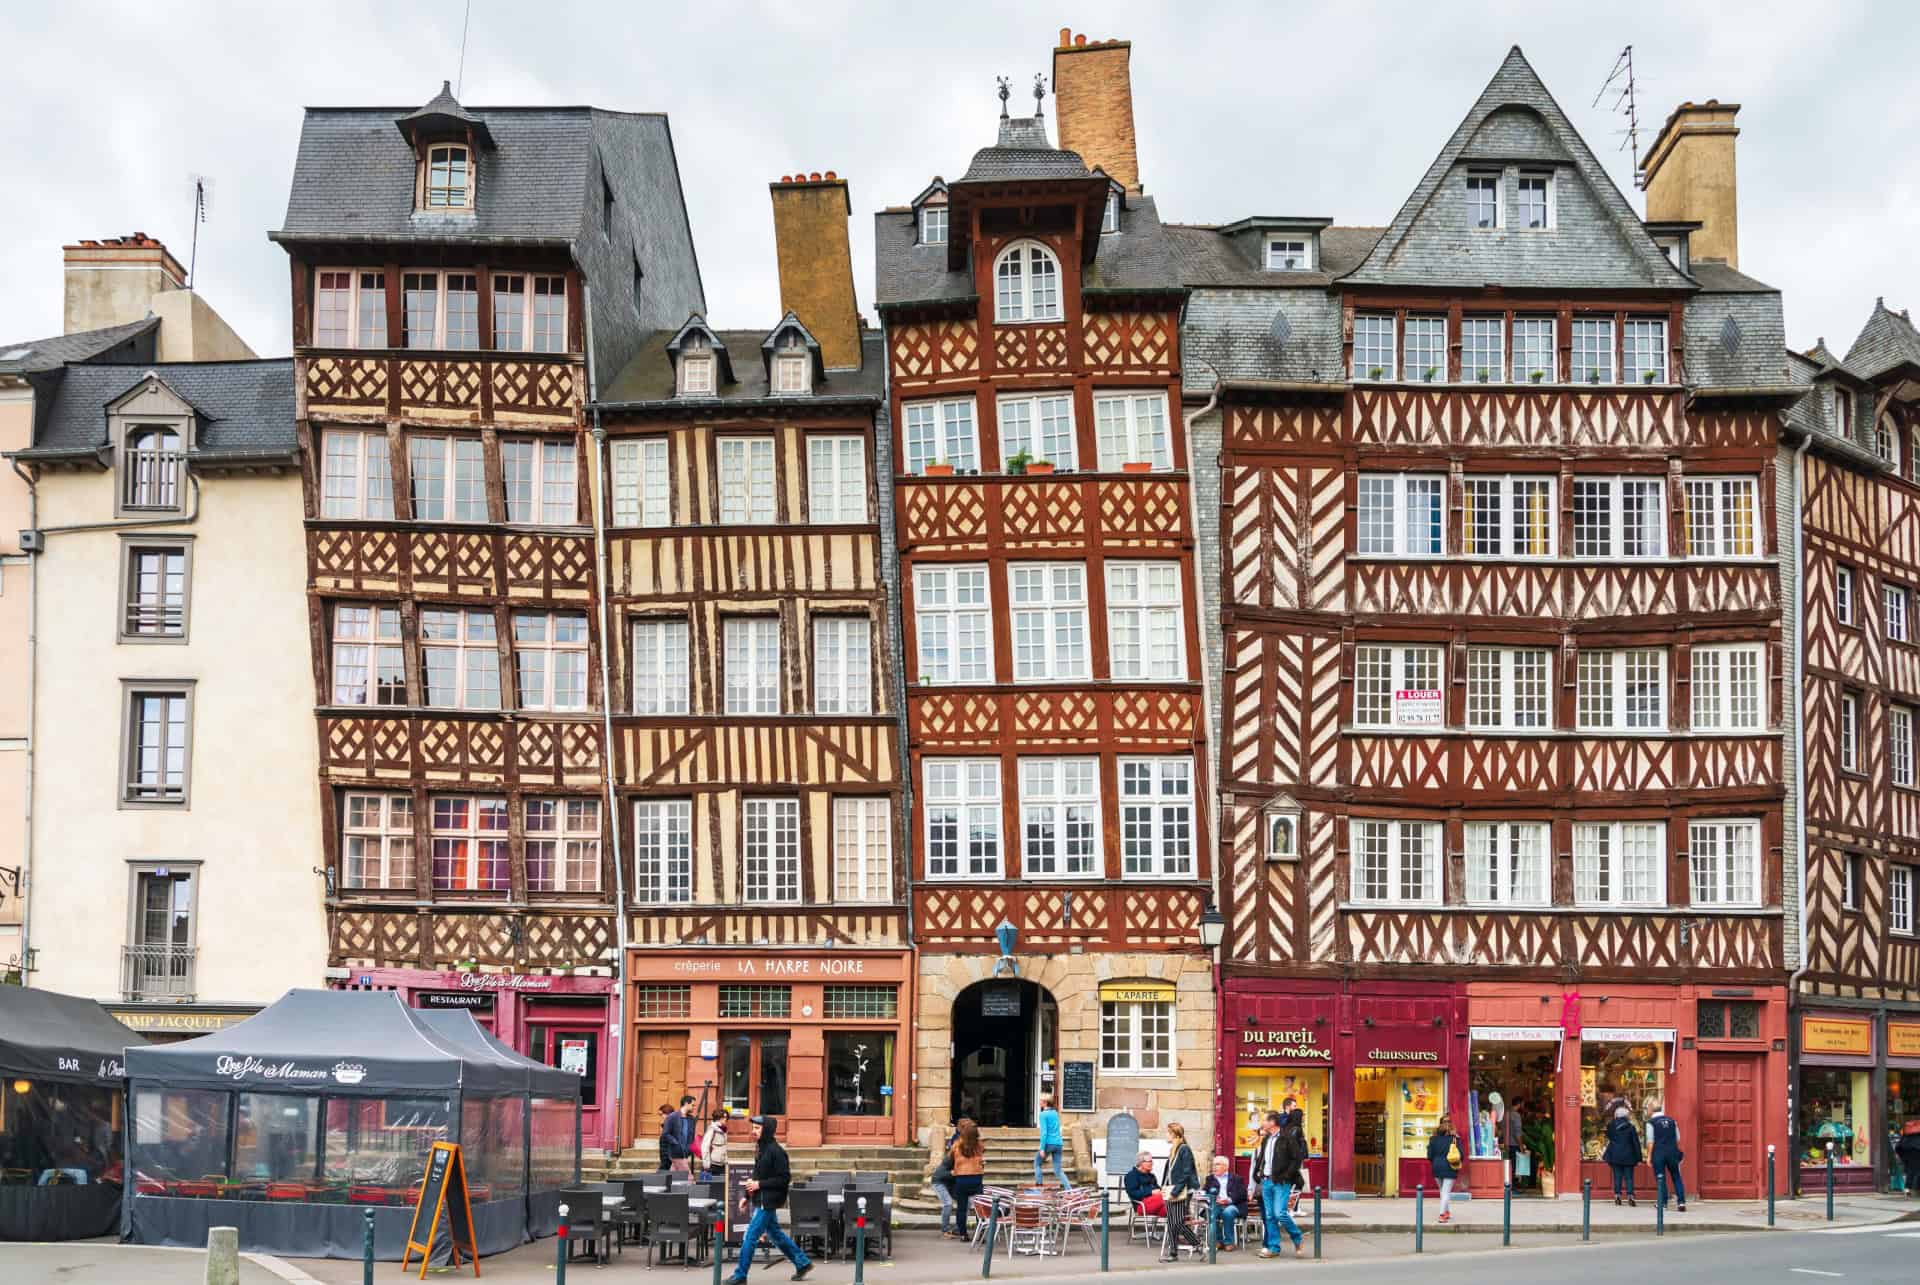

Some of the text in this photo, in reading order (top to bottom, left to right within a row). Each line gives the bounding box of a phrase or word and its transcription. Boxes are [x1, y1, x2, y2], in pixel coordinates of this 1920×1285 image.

[1408, 690, 1439, 699] LOUER
[674, 959, 864, 975] crêperie LA HARPE NOIRE
[430, 995, 481, 1005] RESTAURANT
[158, 1015, 224, 1029] JACQUET
[1256, 1047, 1280, 1058] au
[1281, 1044, 1332, 1061] même
[1368, 1047, 1438, 1061] chaussures
[58, 1057, 81, 1072] BAR
[279, 1061, 329, 1080] Maman
